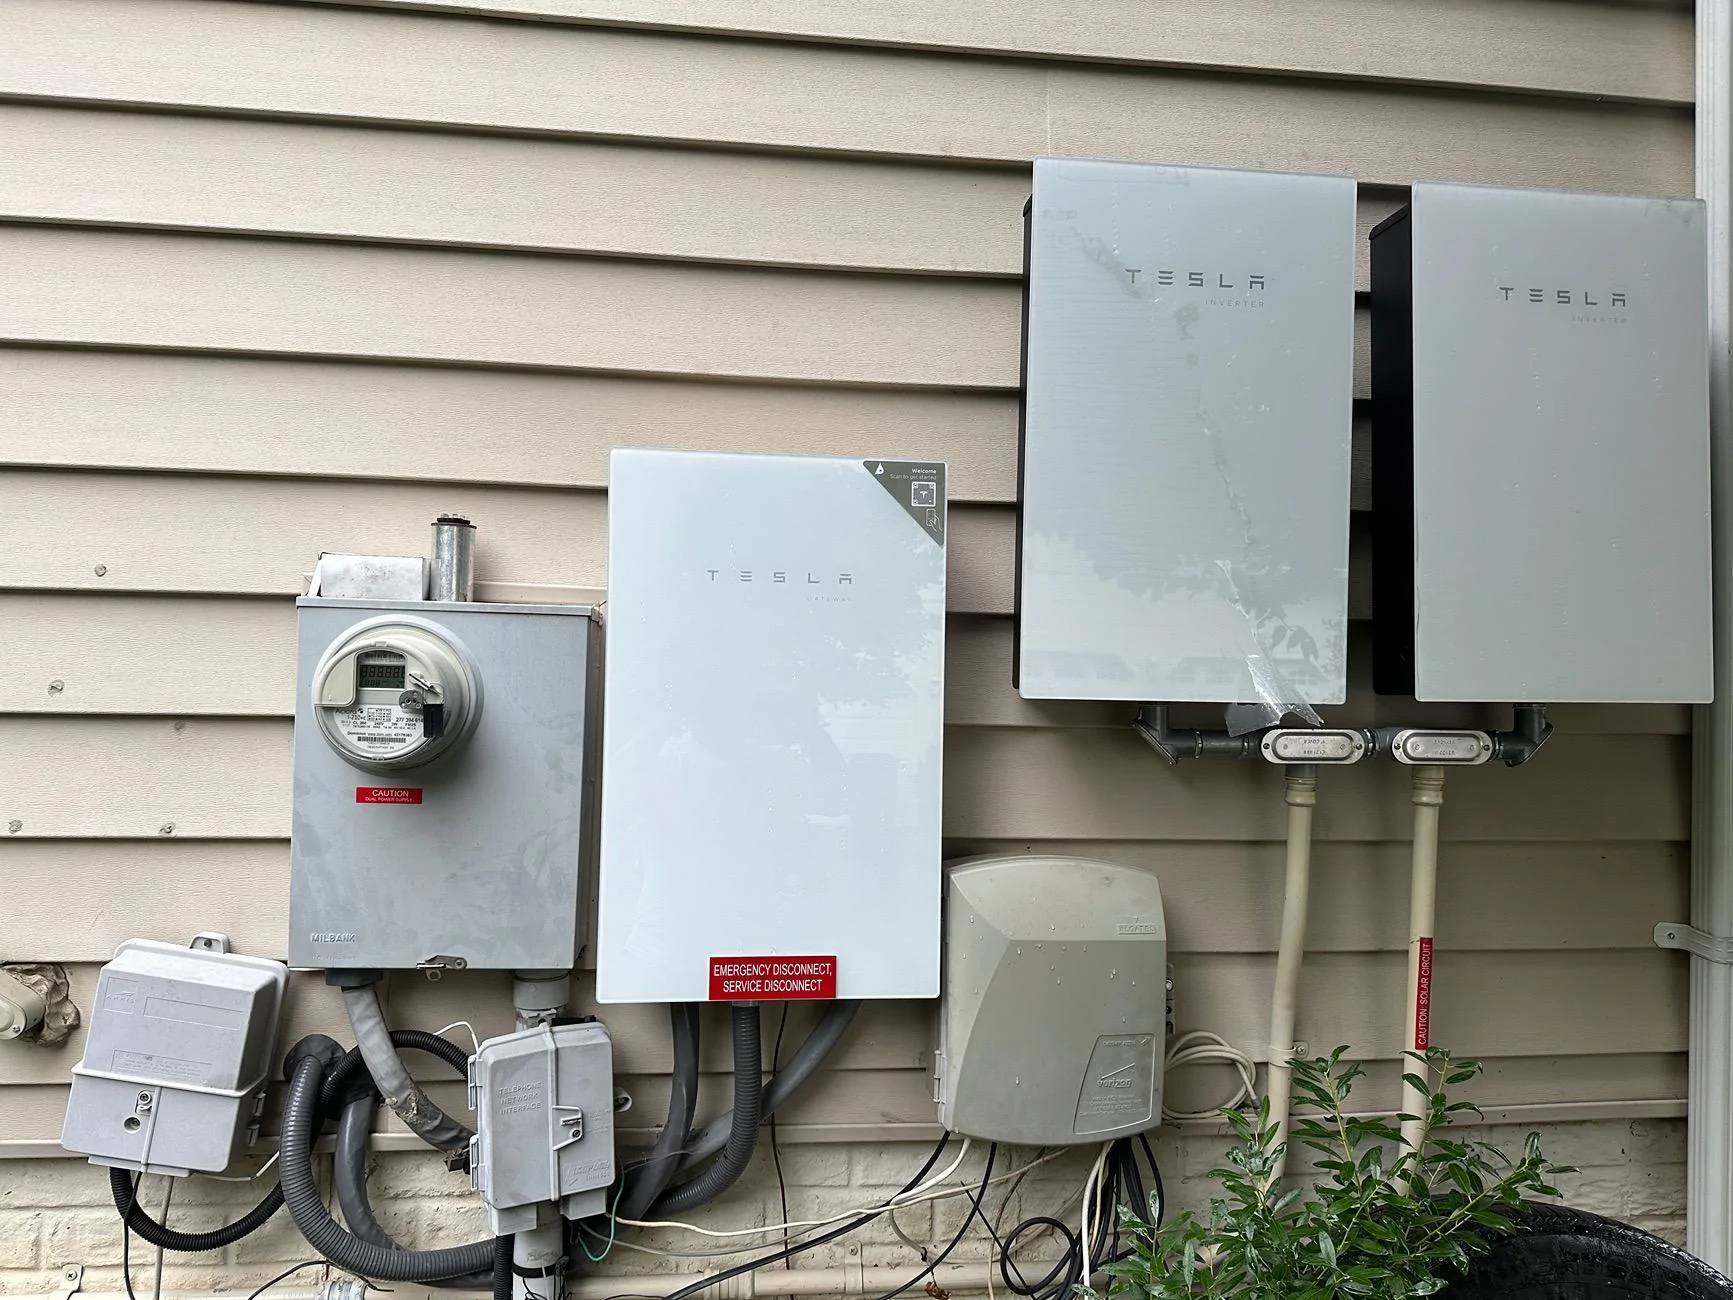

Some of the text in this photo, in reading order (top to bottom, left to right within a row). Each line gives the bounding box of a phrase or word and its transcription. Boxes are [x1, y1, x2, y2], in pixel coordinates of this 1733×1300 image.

[1125, 269, 1265, 290] TESLA
[1205, 299, 1265, 308] INVERTER
[1499, 287, 1626, 307] TESLA
[1572, 316, 1627, 324] INVERTER
[707, 570, 852, 584] TESLA
[372, 789, 409, 797] CAUTION
[310, 933, 356, 943] MILBANK
[1421, 943, 1431, 976] CIRCUIT
[713, 963, 832, 977] EMERGENCY DISCONNECT,
[723, 979, 822, 992] SERVICE DISCONNECT
[1419, 977, 1429, 1004] SOLAR
[498, 1081, 542, 1095] TELEPHONE
[1097, 1077, 1132, 1088] verizon
[500, 1092, 539, 1104] NETWORK
[500, 1102, 541, 1115] INTERFACE
